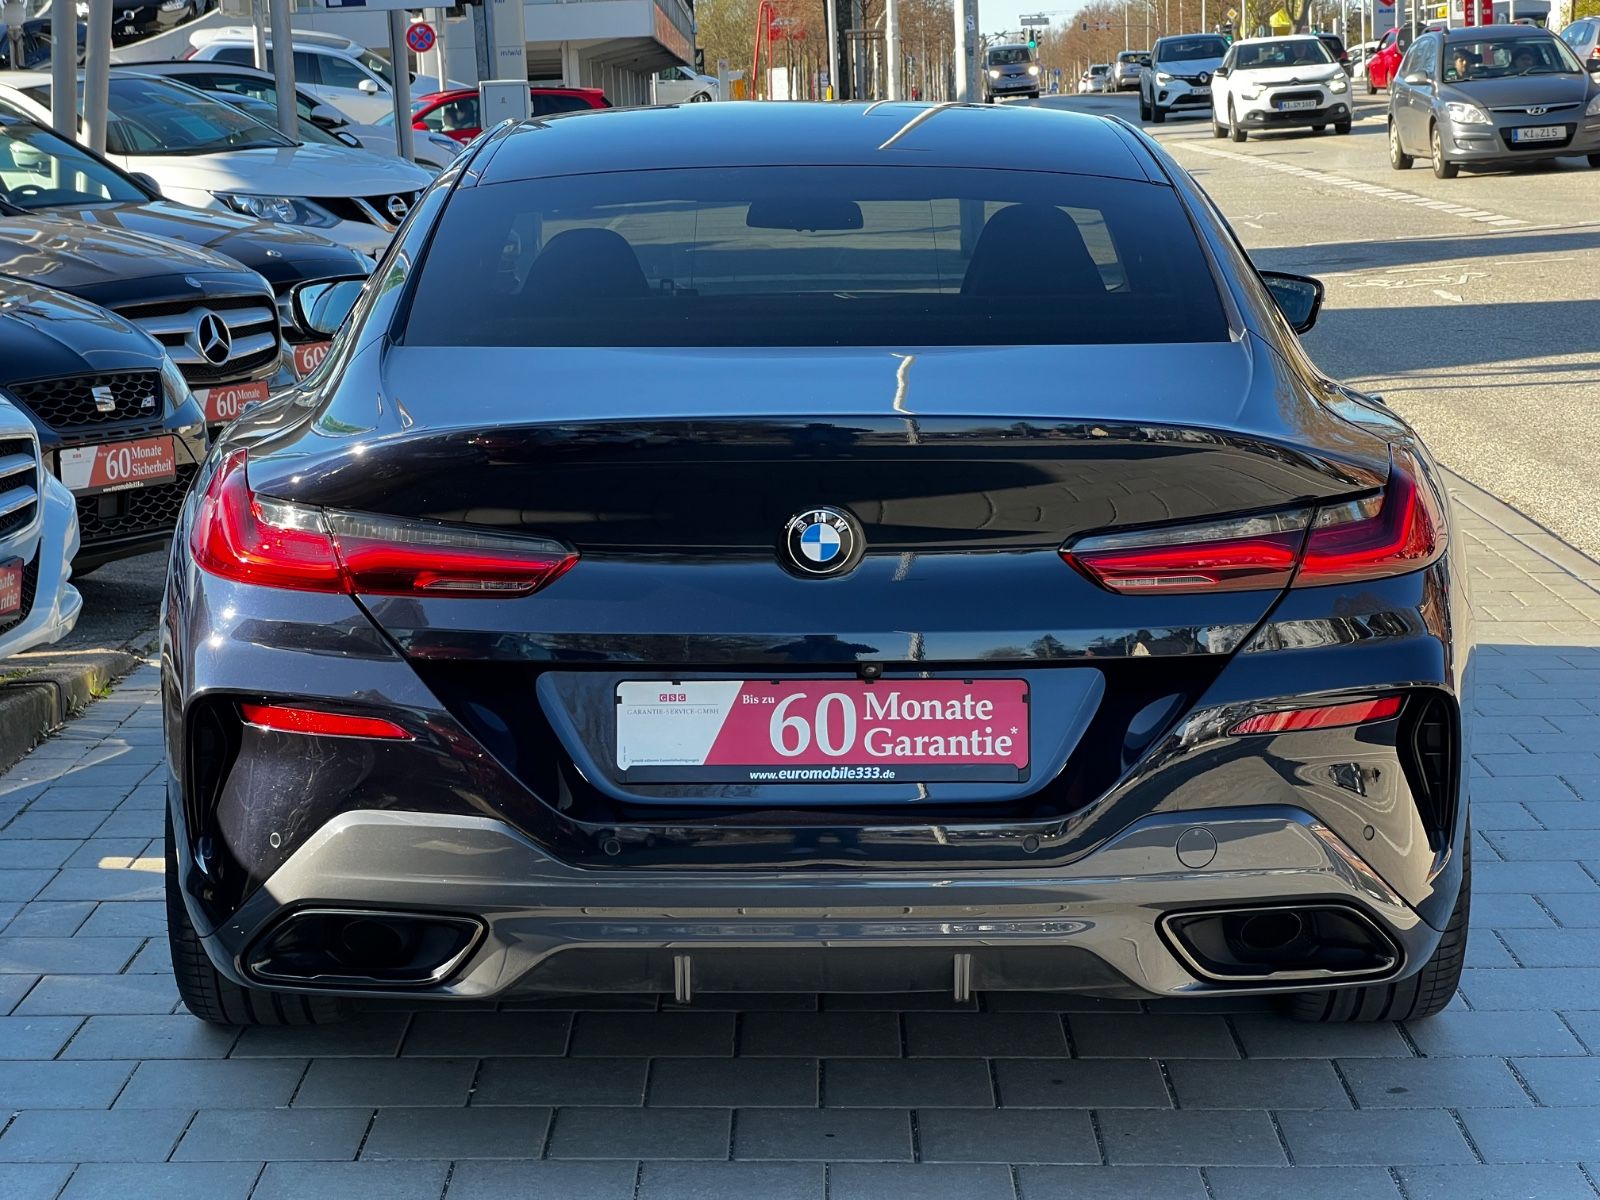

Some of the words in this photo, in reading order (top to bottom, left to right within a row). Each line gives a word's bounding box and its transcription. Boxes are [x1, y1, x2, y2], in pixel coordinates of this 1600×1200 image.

[1523, 130, 1534, 138] KI
[237, 389, 260, 400] Monate
[216, 390, 237, 417] 60
[131, 445, 162, 459] Monate
[106, 447, 131, 480] 60
[794, 512, 848, 534] BMW
[742, 694, 759, 704] Bis
[761, 696, 775, 704] zu
[863, 692, 993, 720] Monate
[627, 707, 719, 716] GARANTIE-SERVICE-GMBH
[769, 692, 857, 757] 60
[749, 766, 895, 779] www.euromobile333.de
